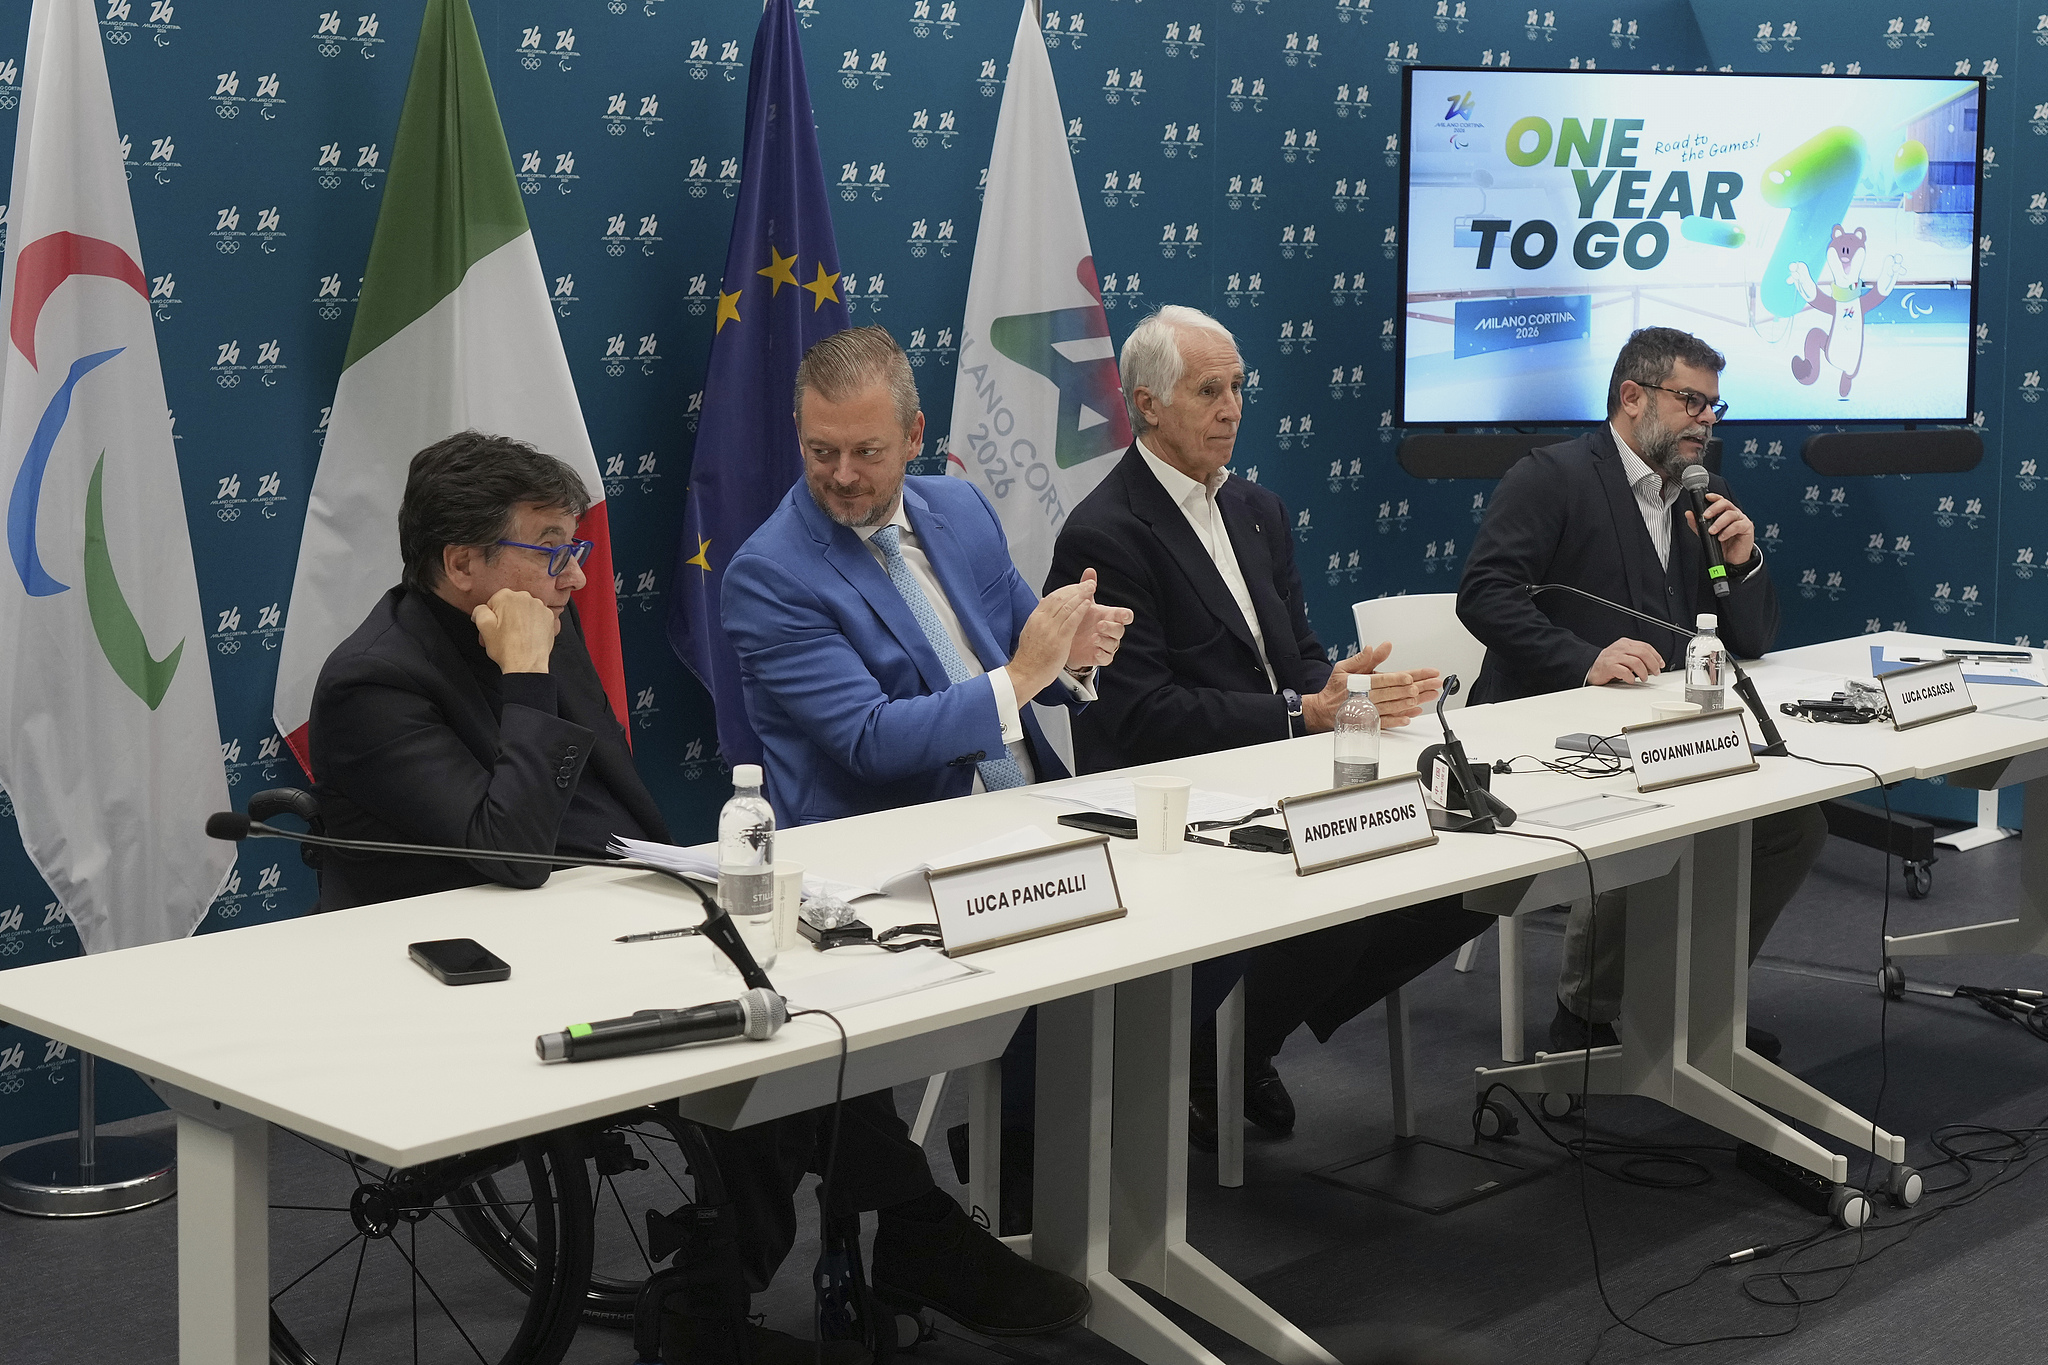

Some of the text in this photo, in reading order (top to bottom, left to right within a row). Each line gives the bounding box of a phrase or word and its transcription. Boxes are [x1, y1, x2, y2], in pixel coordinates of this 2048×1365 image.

[1505, 115, 1645, 167] ONE
[1655, 133, 1709, 155] Road to
[1681, 133, 1761, 163] the Games!
[1571, 170, 1743, 219] YEAR
[1470, 219, 1669, 270] TO GO
[1474, 311, 1577, 333] MILANO CORTINA
[1515, 326, 1540, 339] 2026
[967, 422, 1016, 499] 2026
[1902, 681, 1956, 705] LUCA CASASSA
[1641, 730, 1740, 765] GIOVANNI MALAGÒ
[1305, 804, 1417, 843] ANDREW PARSONS
[967, 873, 1087, 917] LUCA PANCALLI
